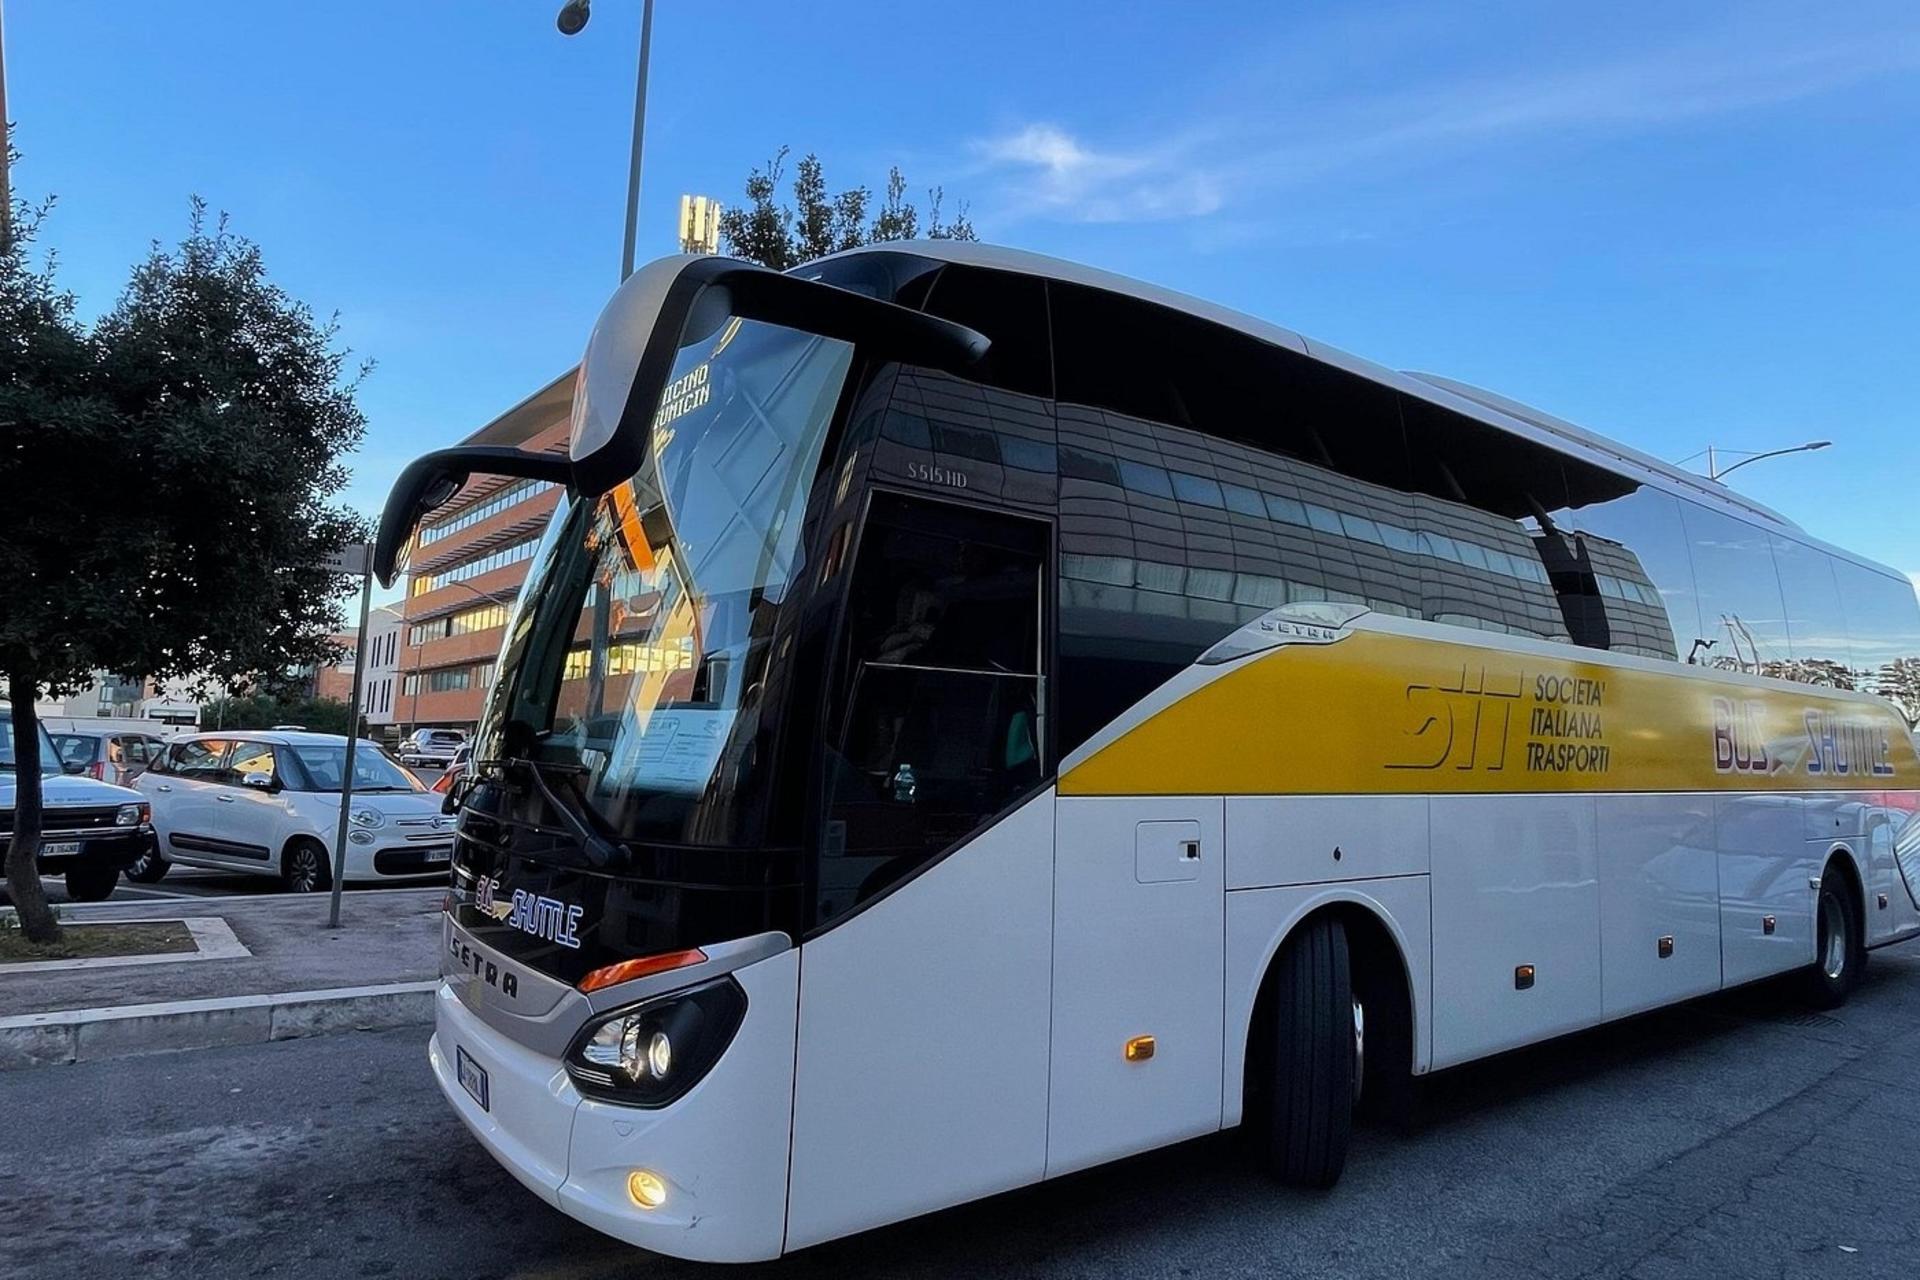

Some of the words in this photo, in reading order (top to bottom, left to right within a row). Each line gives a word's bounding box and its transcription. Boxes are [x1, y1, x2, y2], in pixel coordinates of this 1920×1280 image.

[1261, 620, 1335, 640] SETRA
[1530, 707, 1602, 739] ITALIANA
[1712, 696, 1770, 776] BUS
[1804, 707, 1896, 777] SHUTTLE
[1526, 741, 1610, 773] TRASPORTI
[508, 888, 584, 949] SHUTTLE
[450, 936, 519, 999] SETRA
